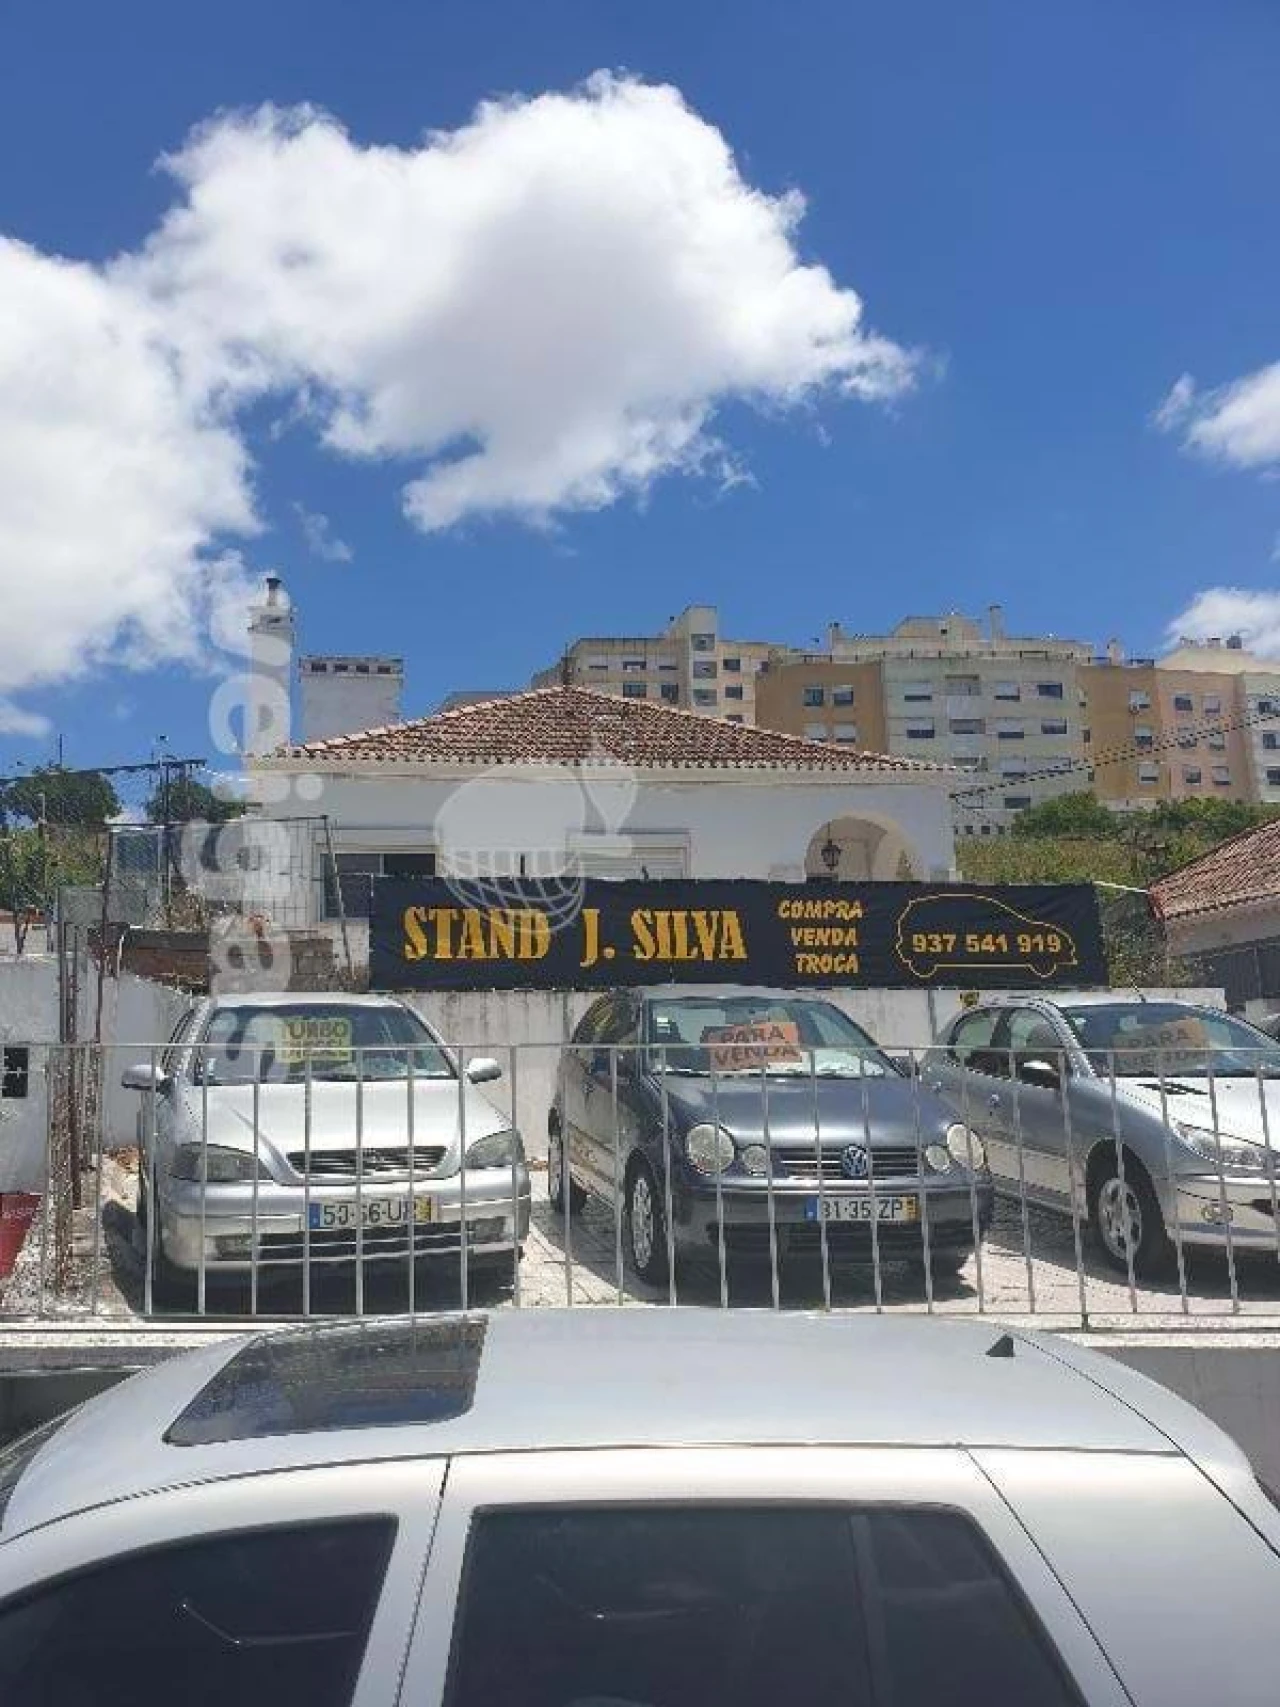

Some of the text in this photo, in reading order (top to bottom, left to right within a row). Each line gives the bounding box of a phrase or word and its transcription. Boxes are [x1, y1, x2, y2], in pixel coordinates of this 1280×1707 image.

[778, 900, 863, 919] COMPRA
[404, 906, 748, 968] STAND J. SILVA
[790, 927, 860, 947] VENDA
[912, 933, 1062, 953] 937 541 919
[794, 954, 860, 975] TROCA
